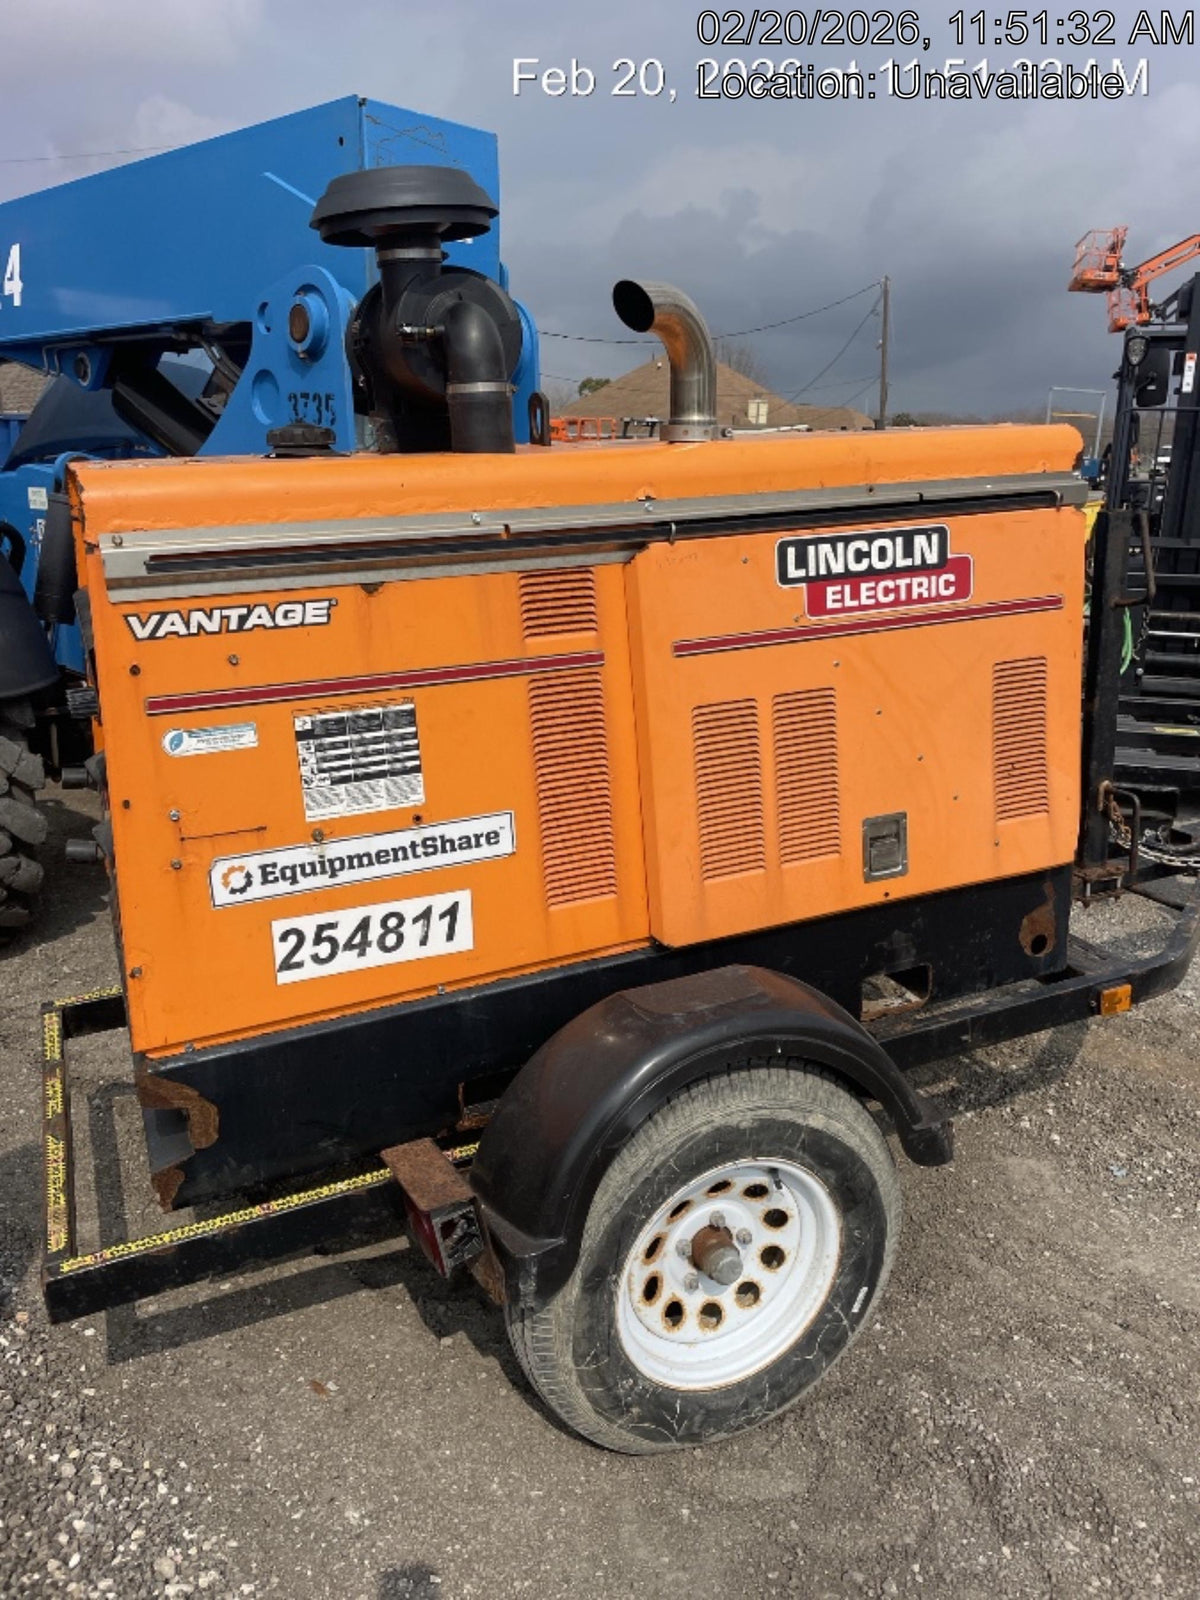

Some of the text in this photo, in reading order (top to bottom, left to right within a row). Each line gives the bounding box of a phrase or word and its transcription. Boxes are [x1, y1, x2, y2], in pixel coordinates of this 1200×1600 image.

[786, 532, 940, 579] LINCOLN
[825, 573, 956, 610] ELECTRIC
[123, 599, 332, 641] VANTAGE
[275, 900, 460, 974] 254811
